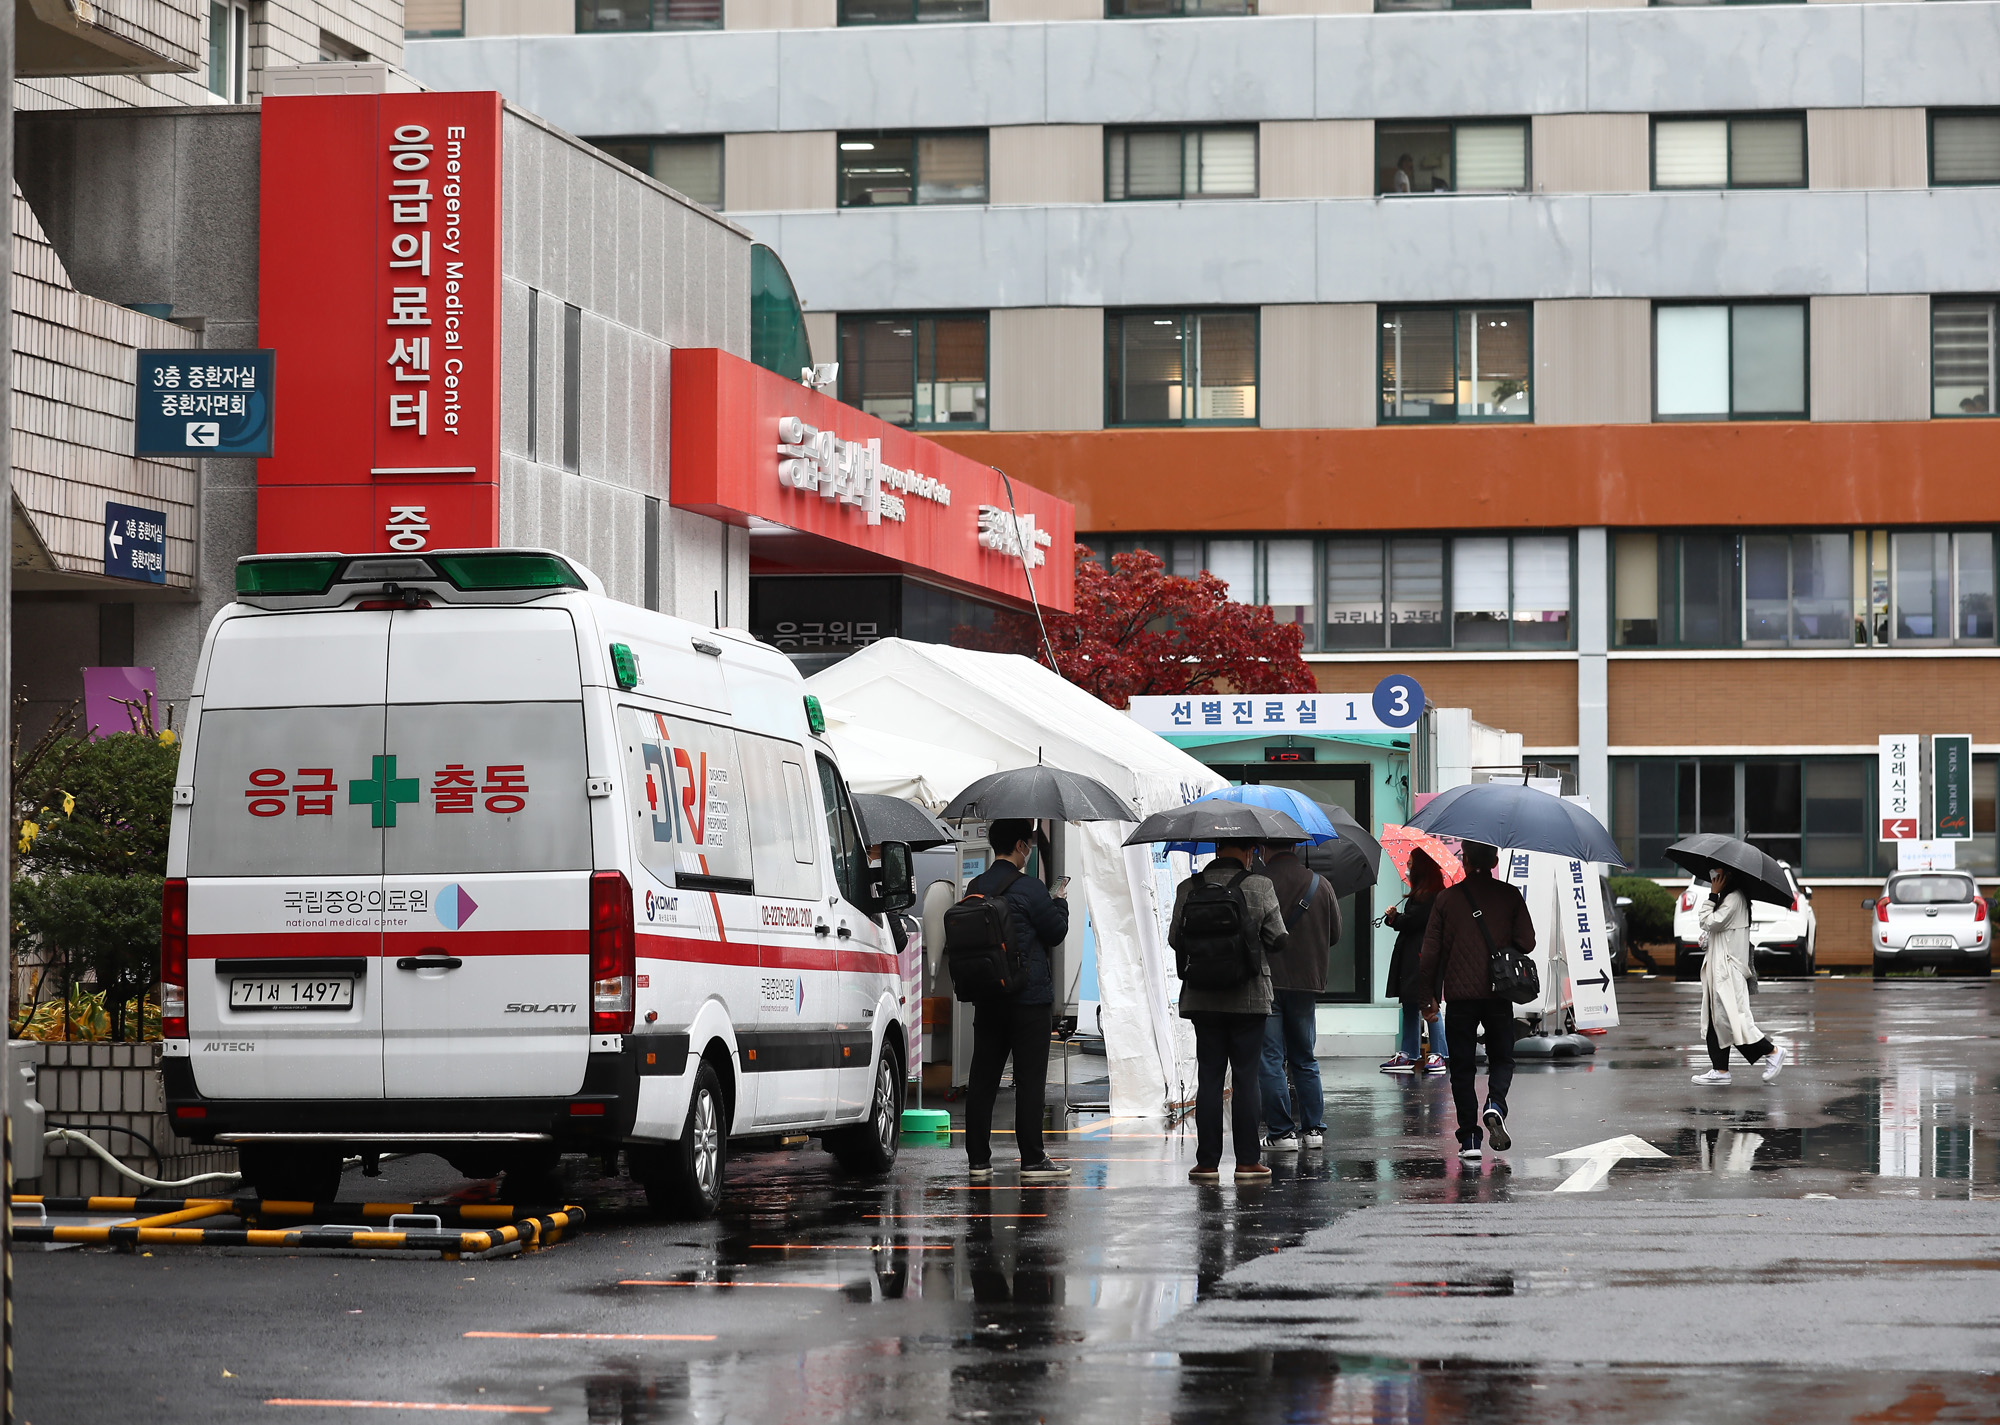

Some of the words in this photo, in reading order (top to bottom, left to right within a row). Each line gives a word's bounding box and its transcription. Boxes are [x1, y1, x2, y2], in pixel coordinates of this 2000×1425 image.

[443, 126, 466, 254] Emergency
[387, 125, 434, 436] 응급의료센터
[445, 262, 464, 349] Medical
[154, 366, 181, 388] 3층
[188, 366, 256, 388] 중환자실
[161, 394, 246, 416] 중환자면회
[444, 358, 463, 435] Center
[126, 519, 137, 538] 3층
[138, 521, 163, 543] 중환자실
[131, 549, 163, 572] 중환자면회
[1334, 610, 1398, 624] 코로나9
[1171, 699, 1318, 725] 선별진료실
[1345, 702, 1357, 721] 1
[1388, 685, 1410, 717] 3
[1948, 746, 1957, 773] TOUS
[244, 768, 338, 817] 응급
[430, 764, 529, 815] 출동
[1891, 743, 1907, 813] 장례식장
[1947, 784, 1957, 815] JOURS
[284, 889, 428, 914] 국립중앙의료원
[1569, 860, 1594, 961] 별진료실
[286, 918, 327, 927] national
[329, 918, 371, 927] medical
[374, 918, 408, 927] center
[243, 983, 280, 1002] 71서
[291, 982, 341, 1002] 1497
[504, 1002, 577, 1013] SOLATI
[203, 1042, 255, 1052] AUTECH
